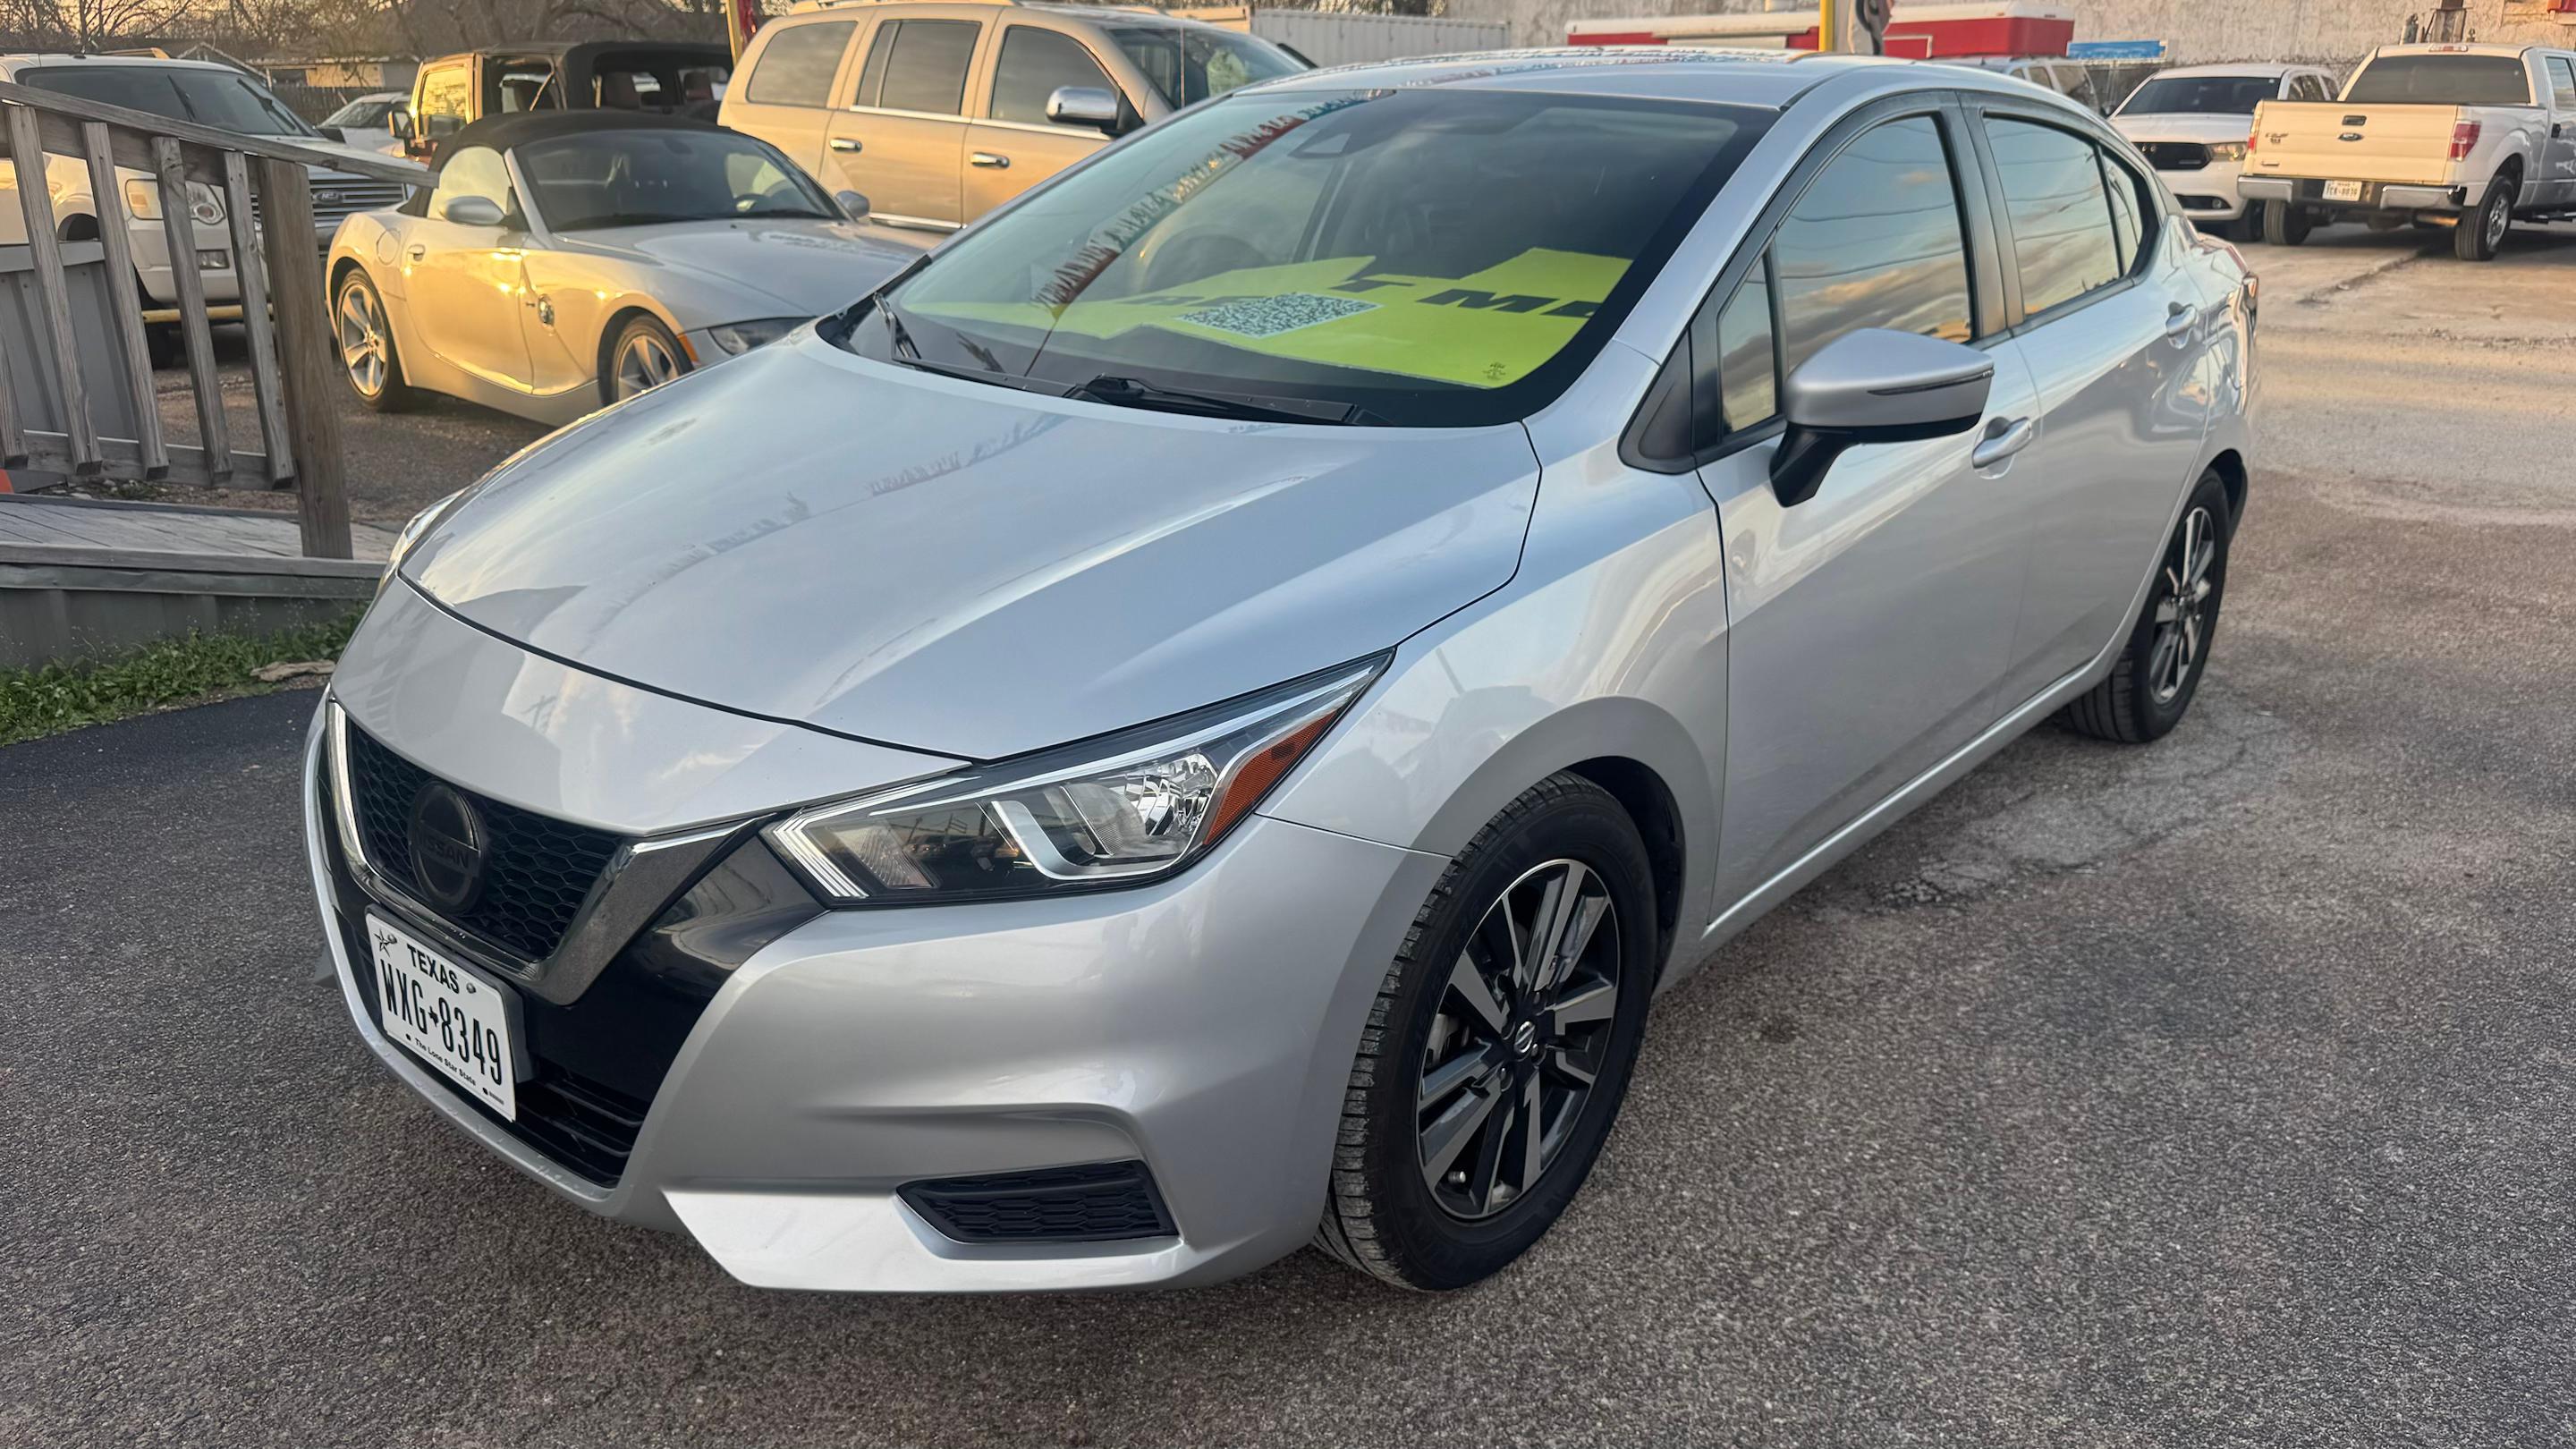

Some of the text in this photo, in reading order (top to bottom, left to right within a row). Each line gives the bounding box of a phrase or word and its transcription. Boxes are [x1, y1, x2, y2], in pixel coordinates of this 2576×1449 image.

[406, 943, 460, 994] TEXAS
[414, 1038, 476, 1086] The Lone Star State
